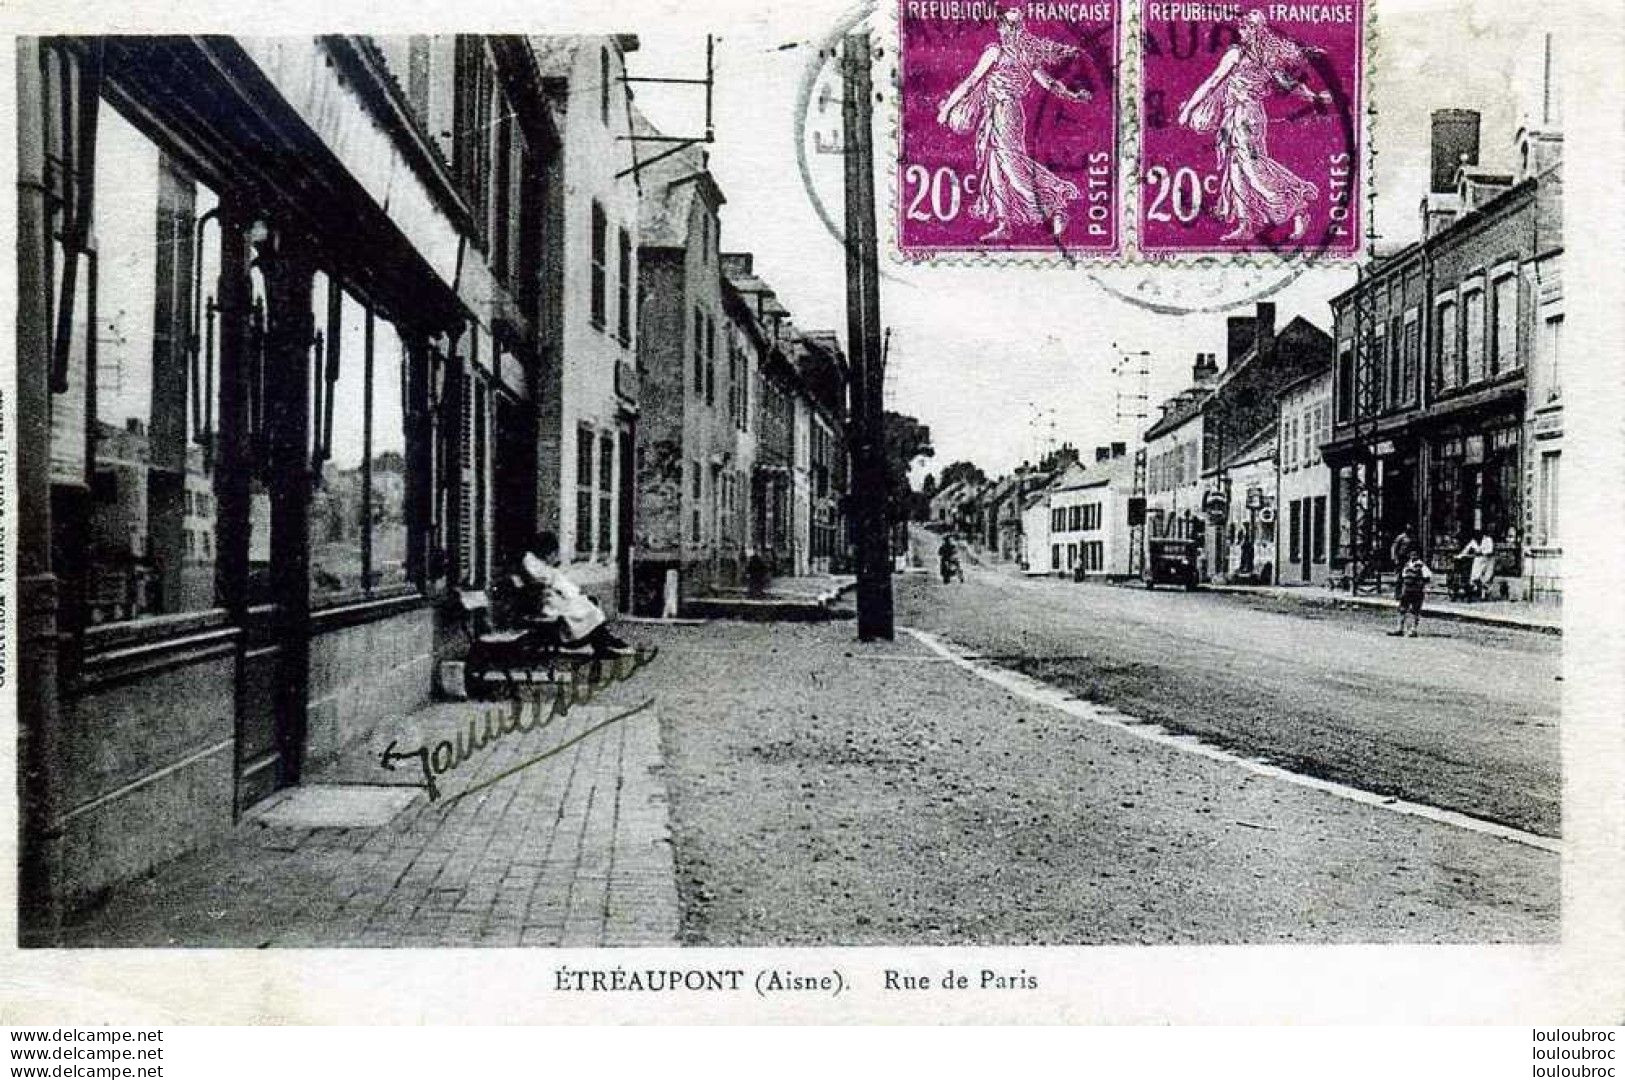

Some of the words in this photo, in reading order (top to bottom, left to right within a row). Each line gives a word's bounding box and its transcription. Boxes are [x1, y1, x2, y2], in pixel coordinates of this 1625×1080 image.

[908, 1, 998, 21] REPUBLIQU
[1027, 2, 1112, 24] FRANÇAISE
[1269, 3, 1353, 25] FRANÇAISE
[1088, 151, 1109, 236] POSTES
[1329, 152, 1350, 236] POSTES
